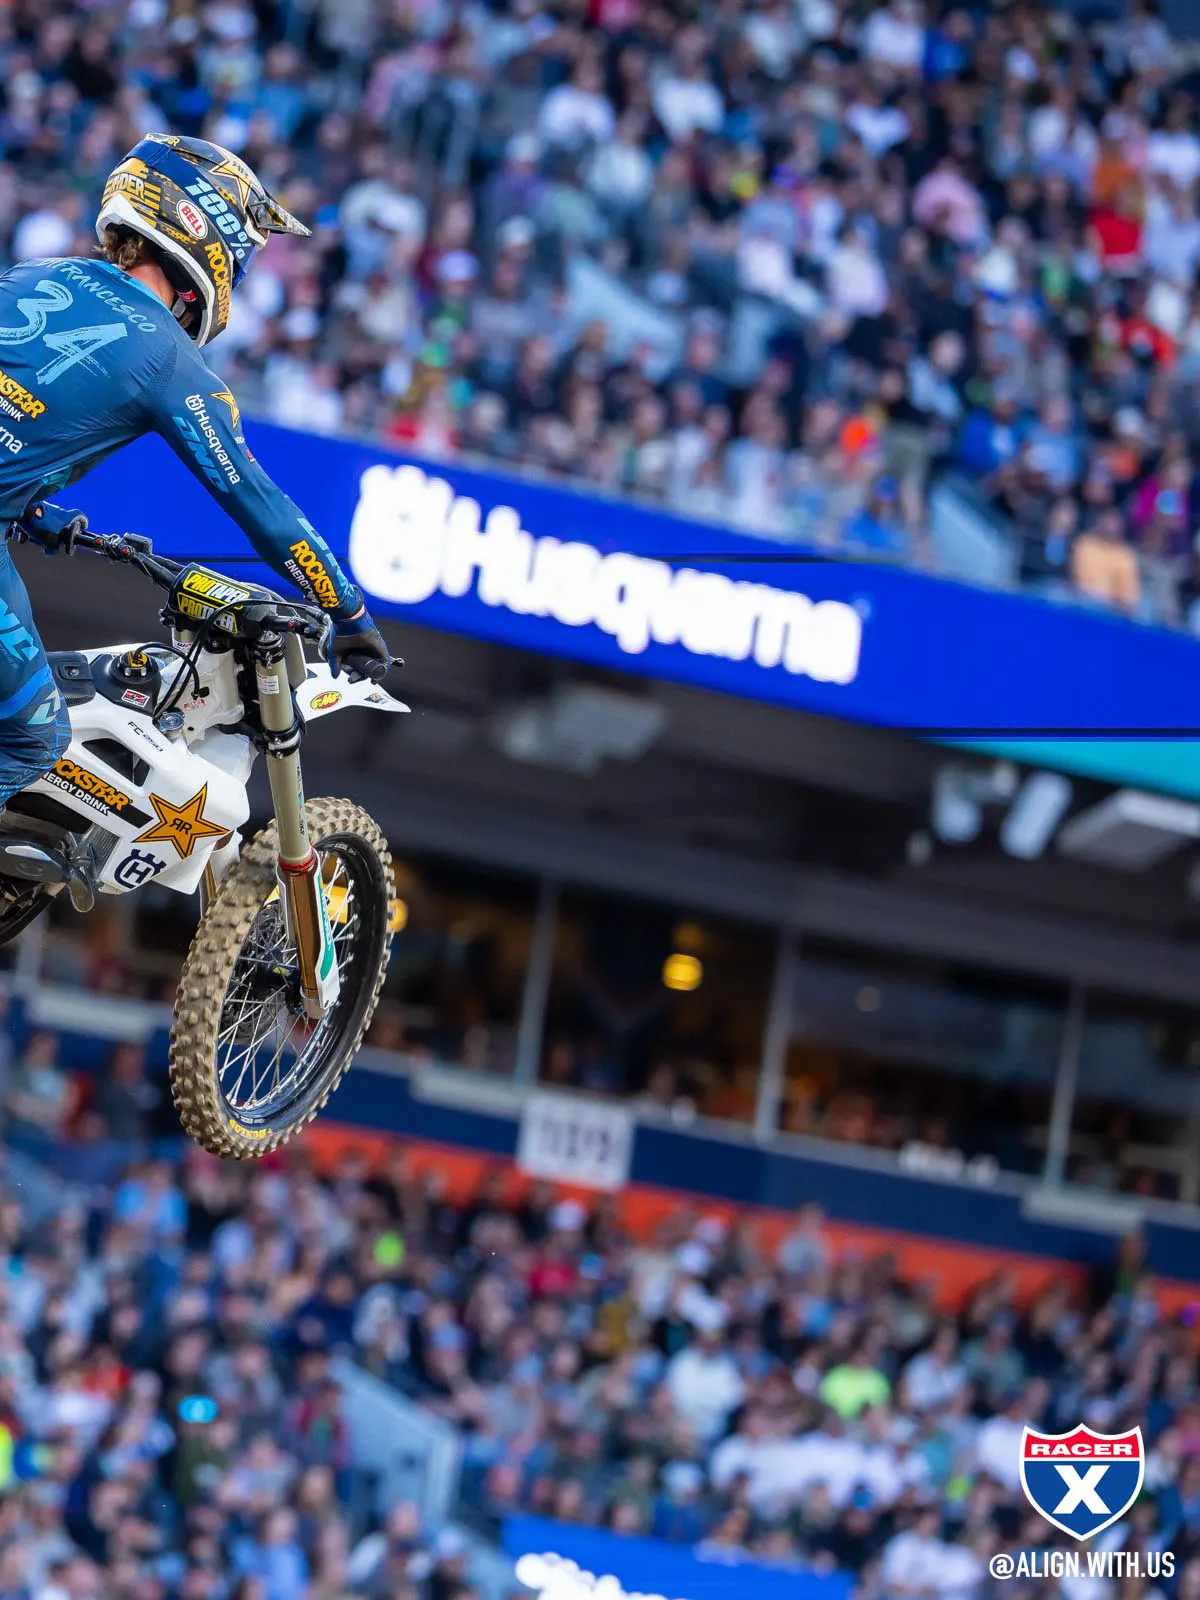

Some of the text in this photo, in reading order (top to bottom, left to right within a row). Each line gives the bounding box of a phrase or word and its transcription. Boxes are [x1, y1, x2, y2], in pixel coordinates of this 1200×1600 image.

[180, 204, 203, 234] BELL
[184, 177, 250, 260] 100%
[195, 408, 241, 485] Husqvarna
[284, 559, 311, 590] ENERGY
[441, 496, 862, 684] Husqvarna
[311, 691, 342, 709] FMF
[128, 721, 144, 736] FC
[43, 771, 111, 815] ERGY DRINK
[55, 758, 129, 812] CKSTAR
